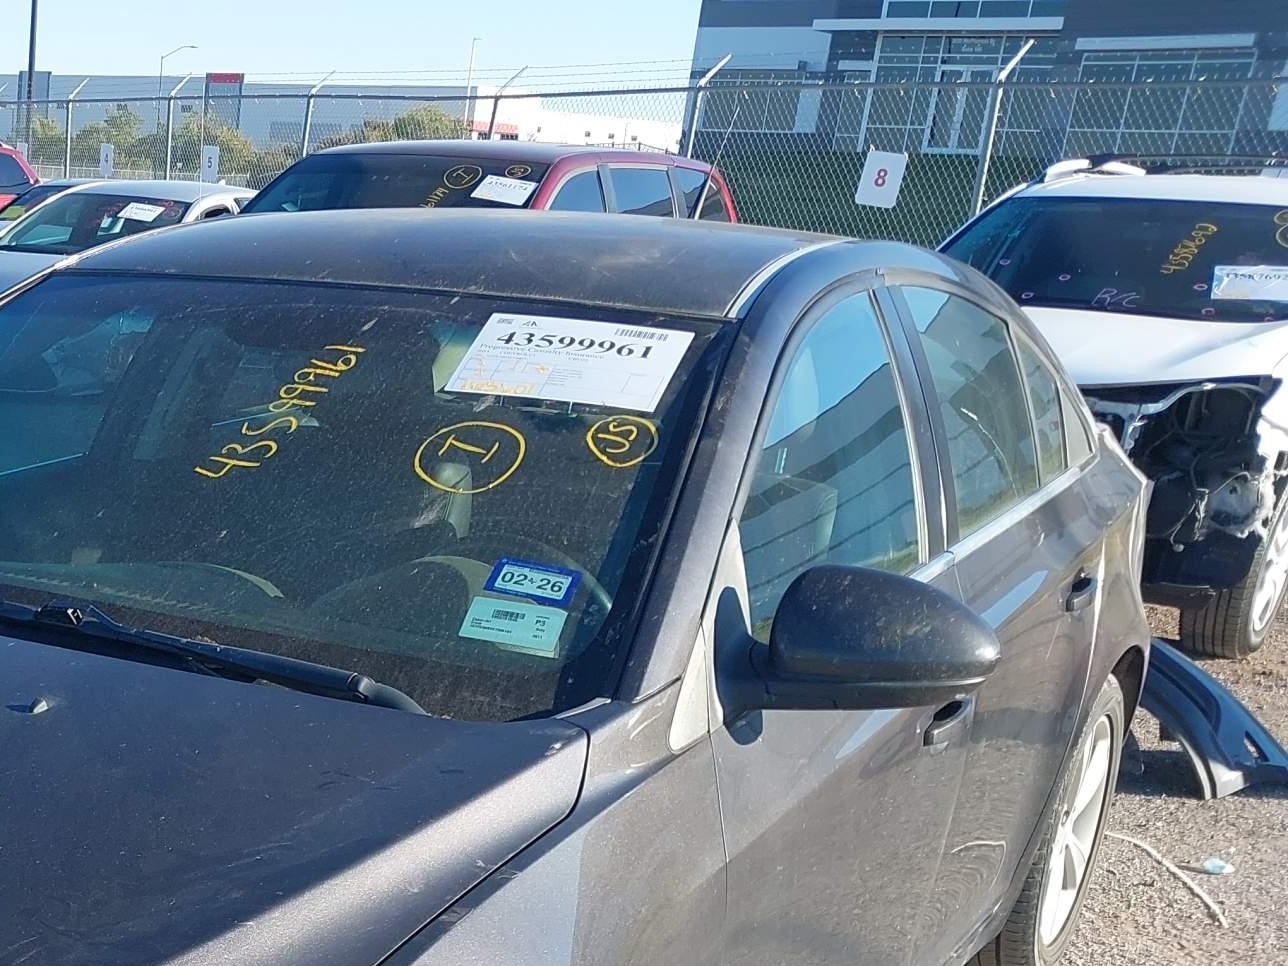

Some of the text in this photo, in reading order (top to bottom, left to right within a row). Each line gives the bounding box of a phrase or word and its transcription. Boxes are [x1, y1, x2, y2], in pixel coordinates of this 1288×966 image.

[207, 156, 213, 169] 5
[874, 168, 888, 187] 8
[496, 331, 654, 360] 43599961
[193, 344, 367, 478] 43599961
[501, 571, 529, 586] 02
[536, 577, 565, 593] 26
